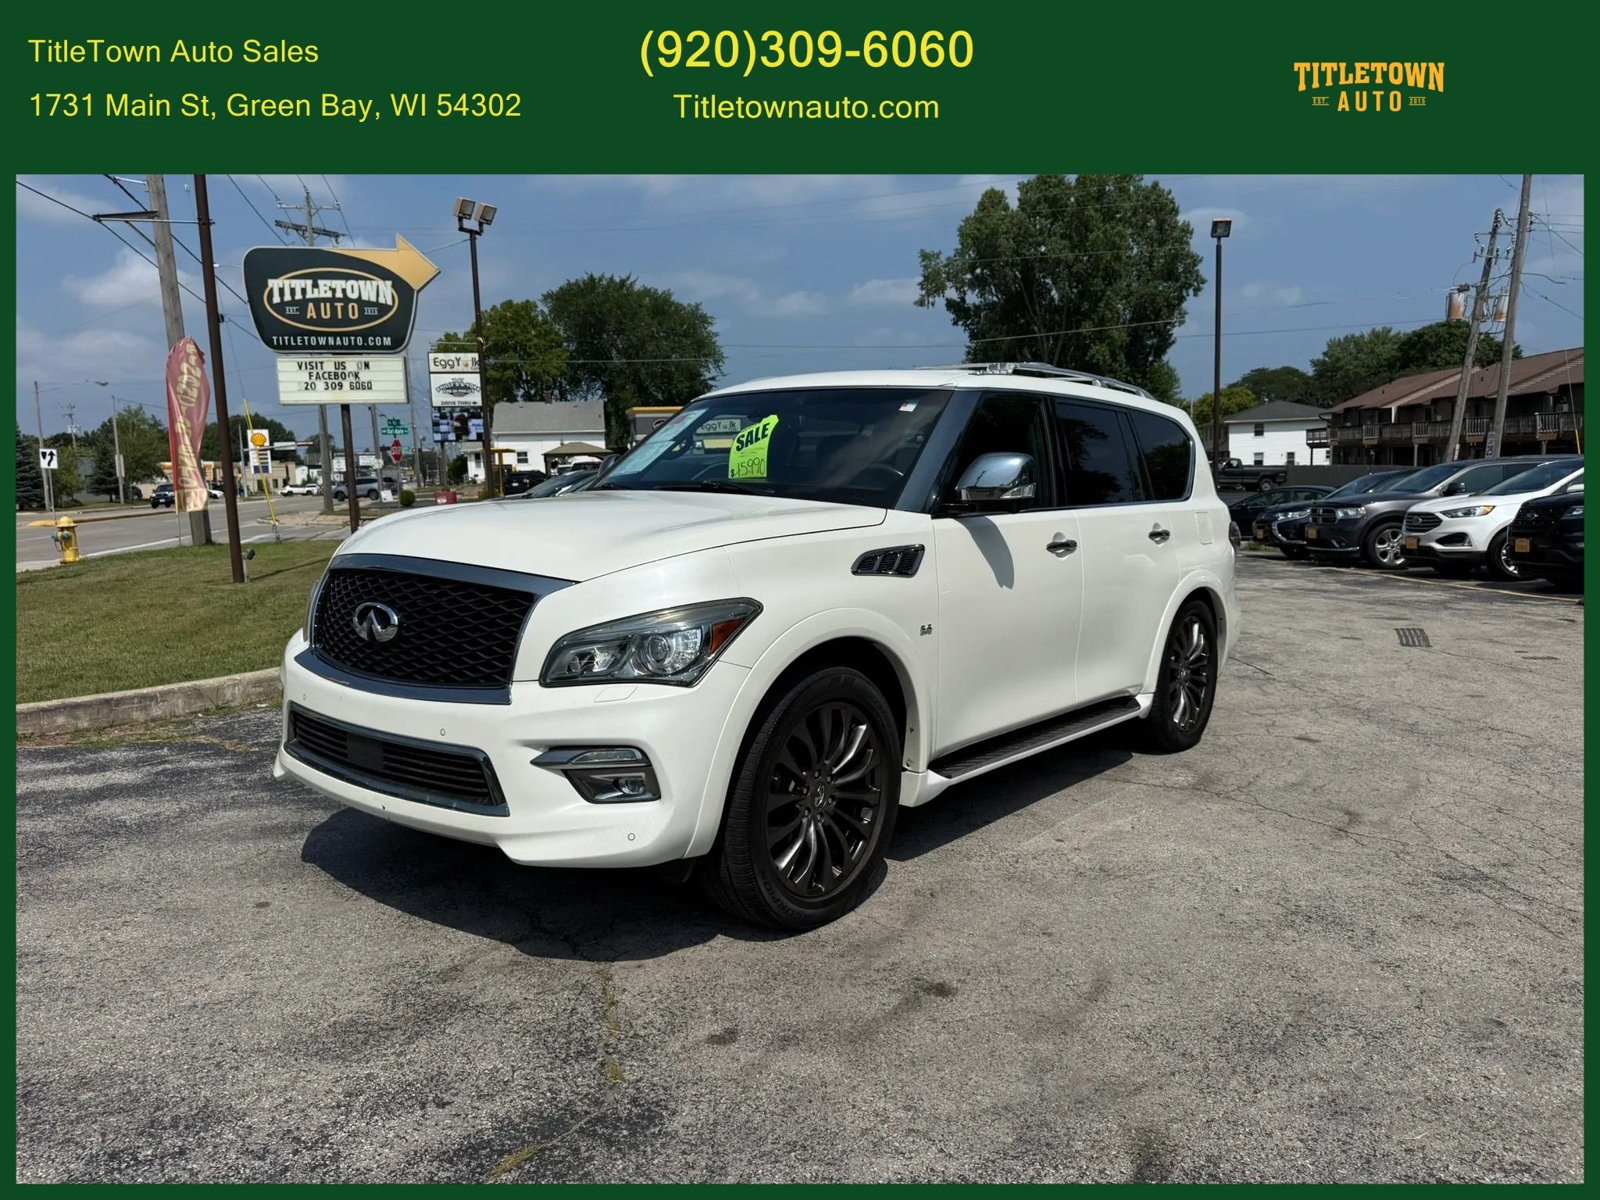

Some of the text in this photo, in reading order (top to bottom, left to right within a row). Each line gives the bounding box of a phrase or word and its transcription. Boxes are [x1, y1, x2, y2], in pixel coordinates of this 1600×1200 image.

[267, 278, 393, 306] TITLETOWN
[306, 302, 359, 320] AUTO
[272, 336, 392, 347] TITLETOWNAUTO.COM
[297, 361, 370, 371] VISIT US ON
[324, 381, 344, 391] 309
[349, 381, 373, 391] 6060
[736, 422, 771, 452] SALE
